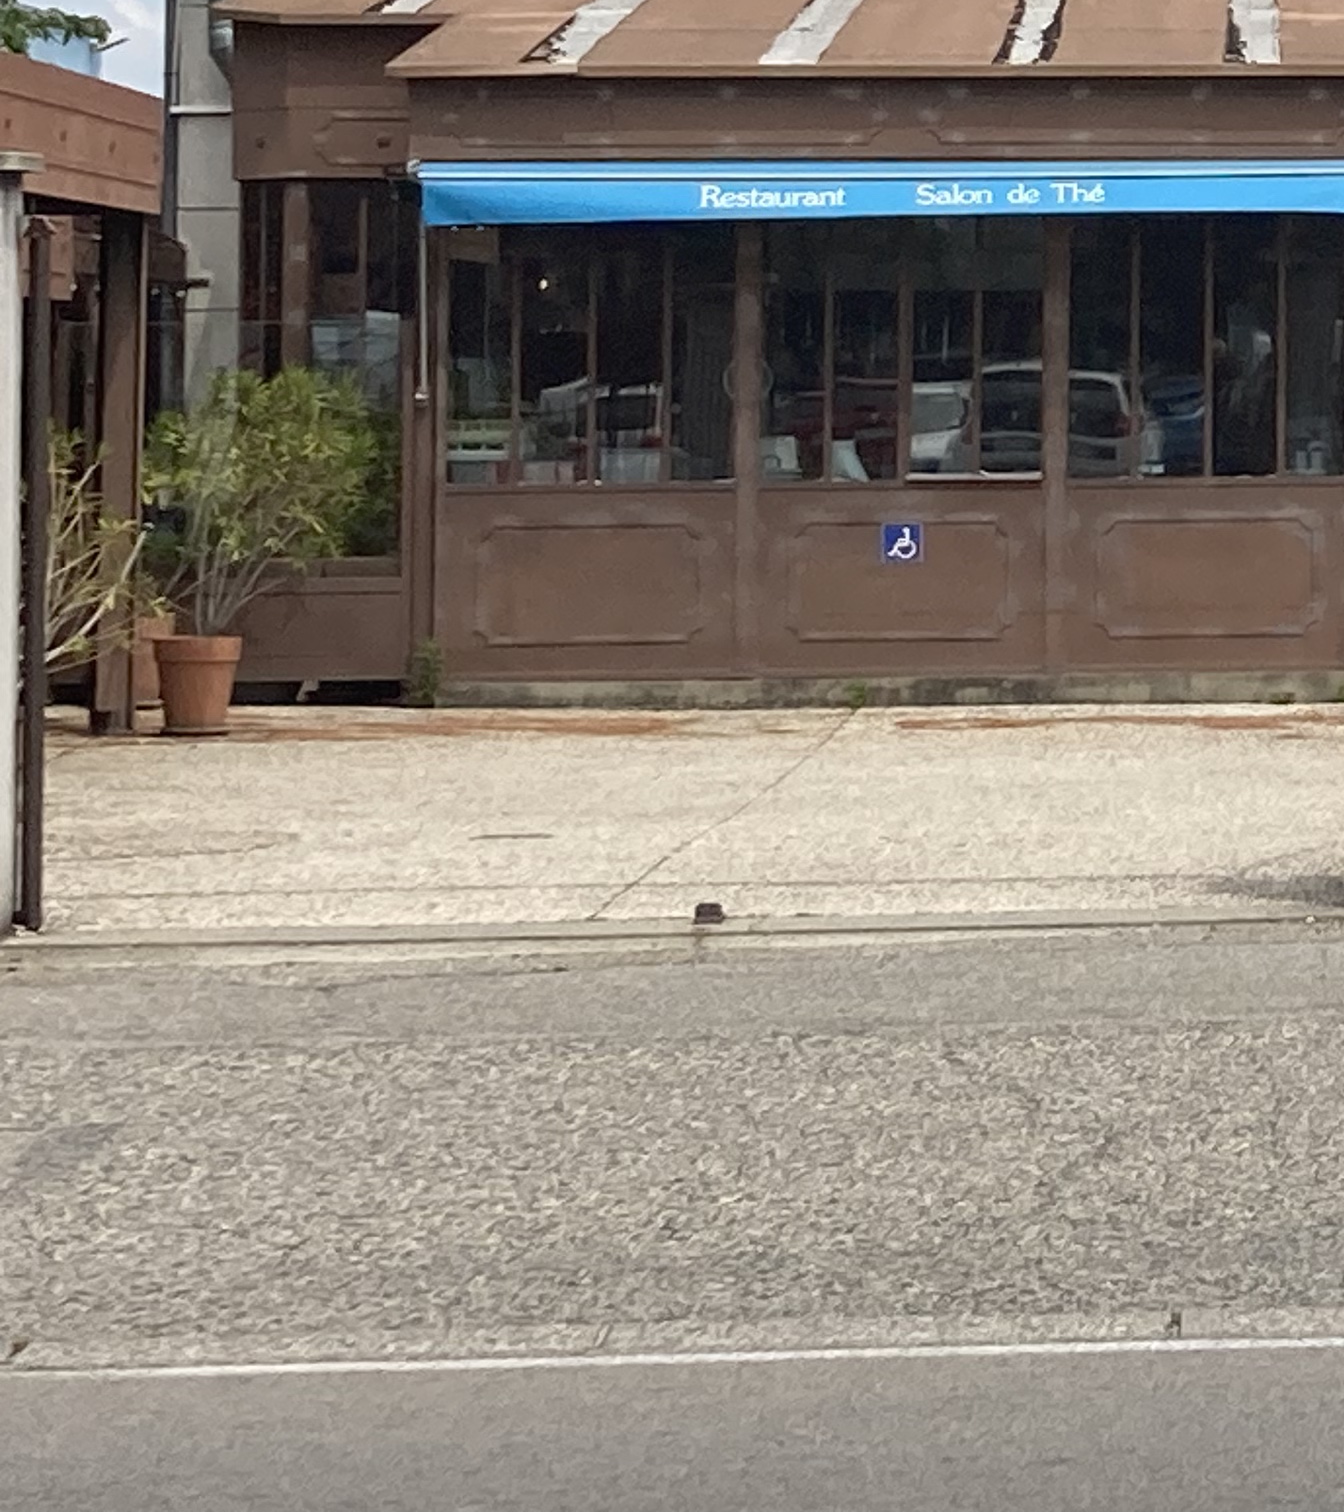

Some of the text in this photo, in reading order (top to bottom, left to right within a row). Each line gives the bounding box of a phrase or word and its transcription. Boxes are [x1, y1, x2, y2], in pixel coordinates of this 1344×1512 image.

[699, 182, 1105, 209] Restaurant Salon de Thé
